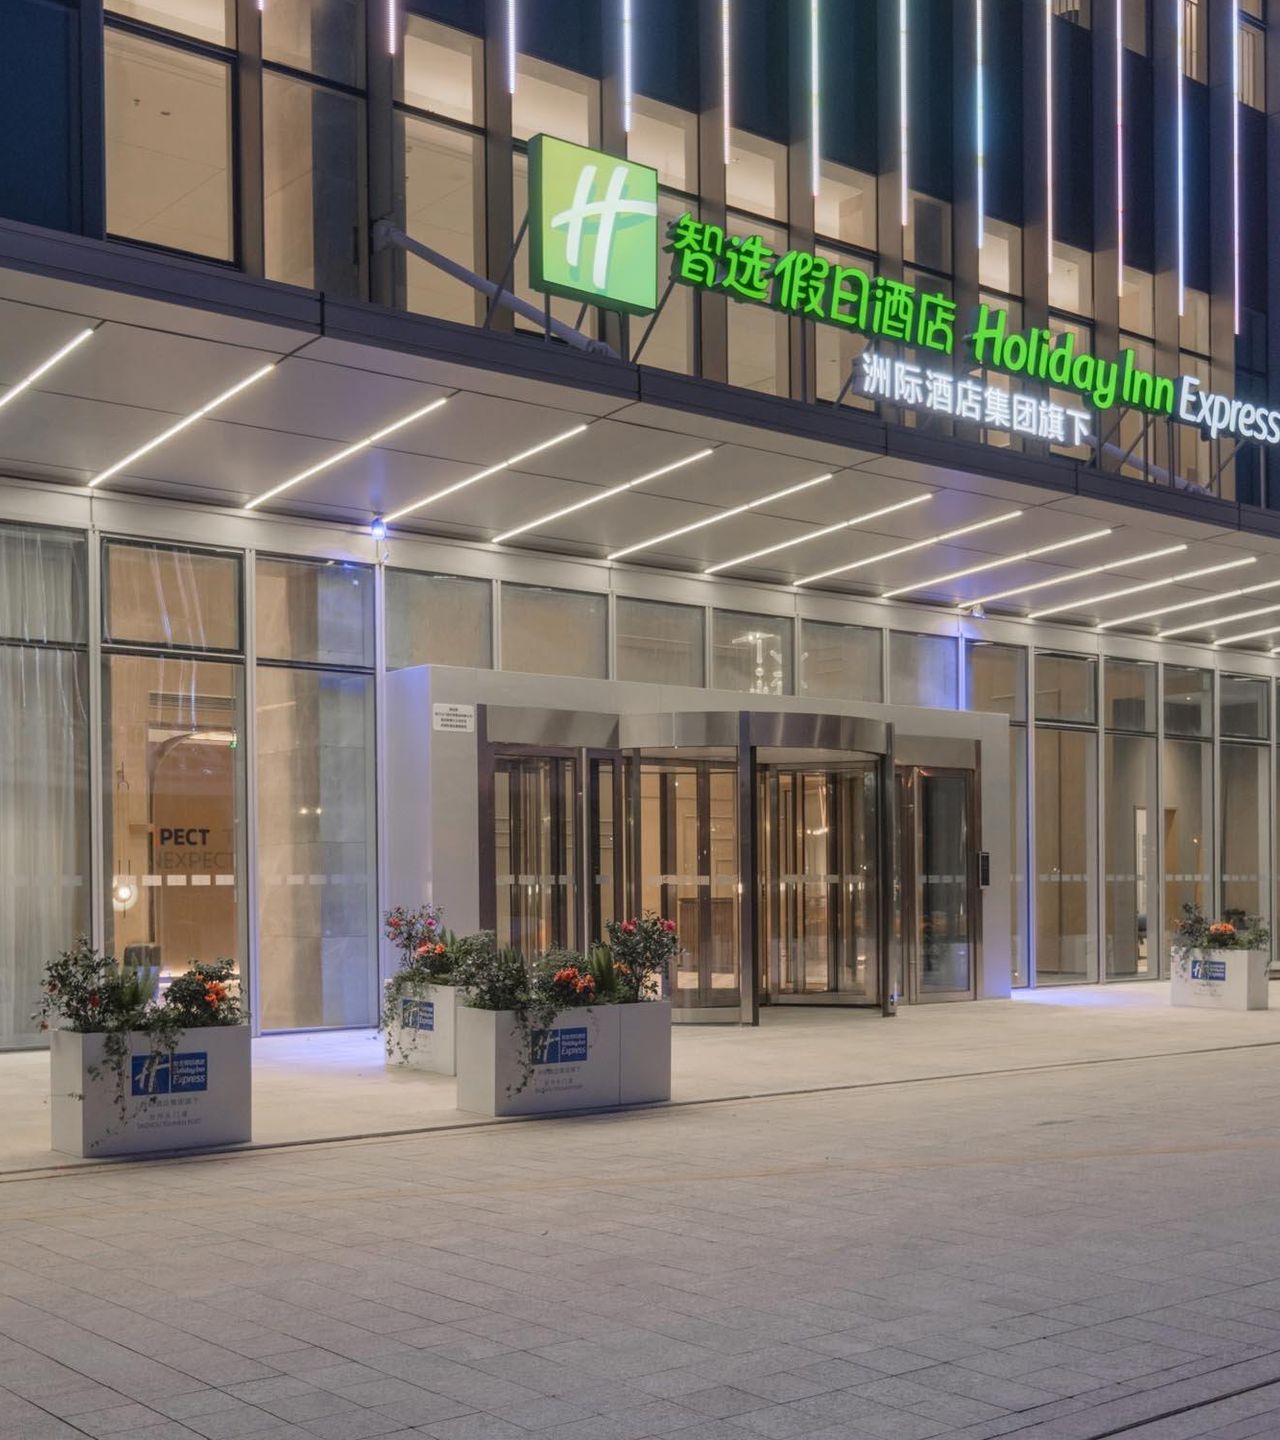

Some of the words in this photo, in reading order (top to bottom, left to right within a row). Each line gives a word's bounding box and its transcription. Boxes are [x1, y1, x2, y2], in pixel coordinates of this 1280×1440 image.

[674, 211, 957, 356] 智选假日酒店
[972, 303, 1118, 409] Holiday
[1122, 348, 1175, 413] Inn
[862, 352, 1092, 446] 洲际酒店集团旗下
[155, 826, 210, 847] PECT
